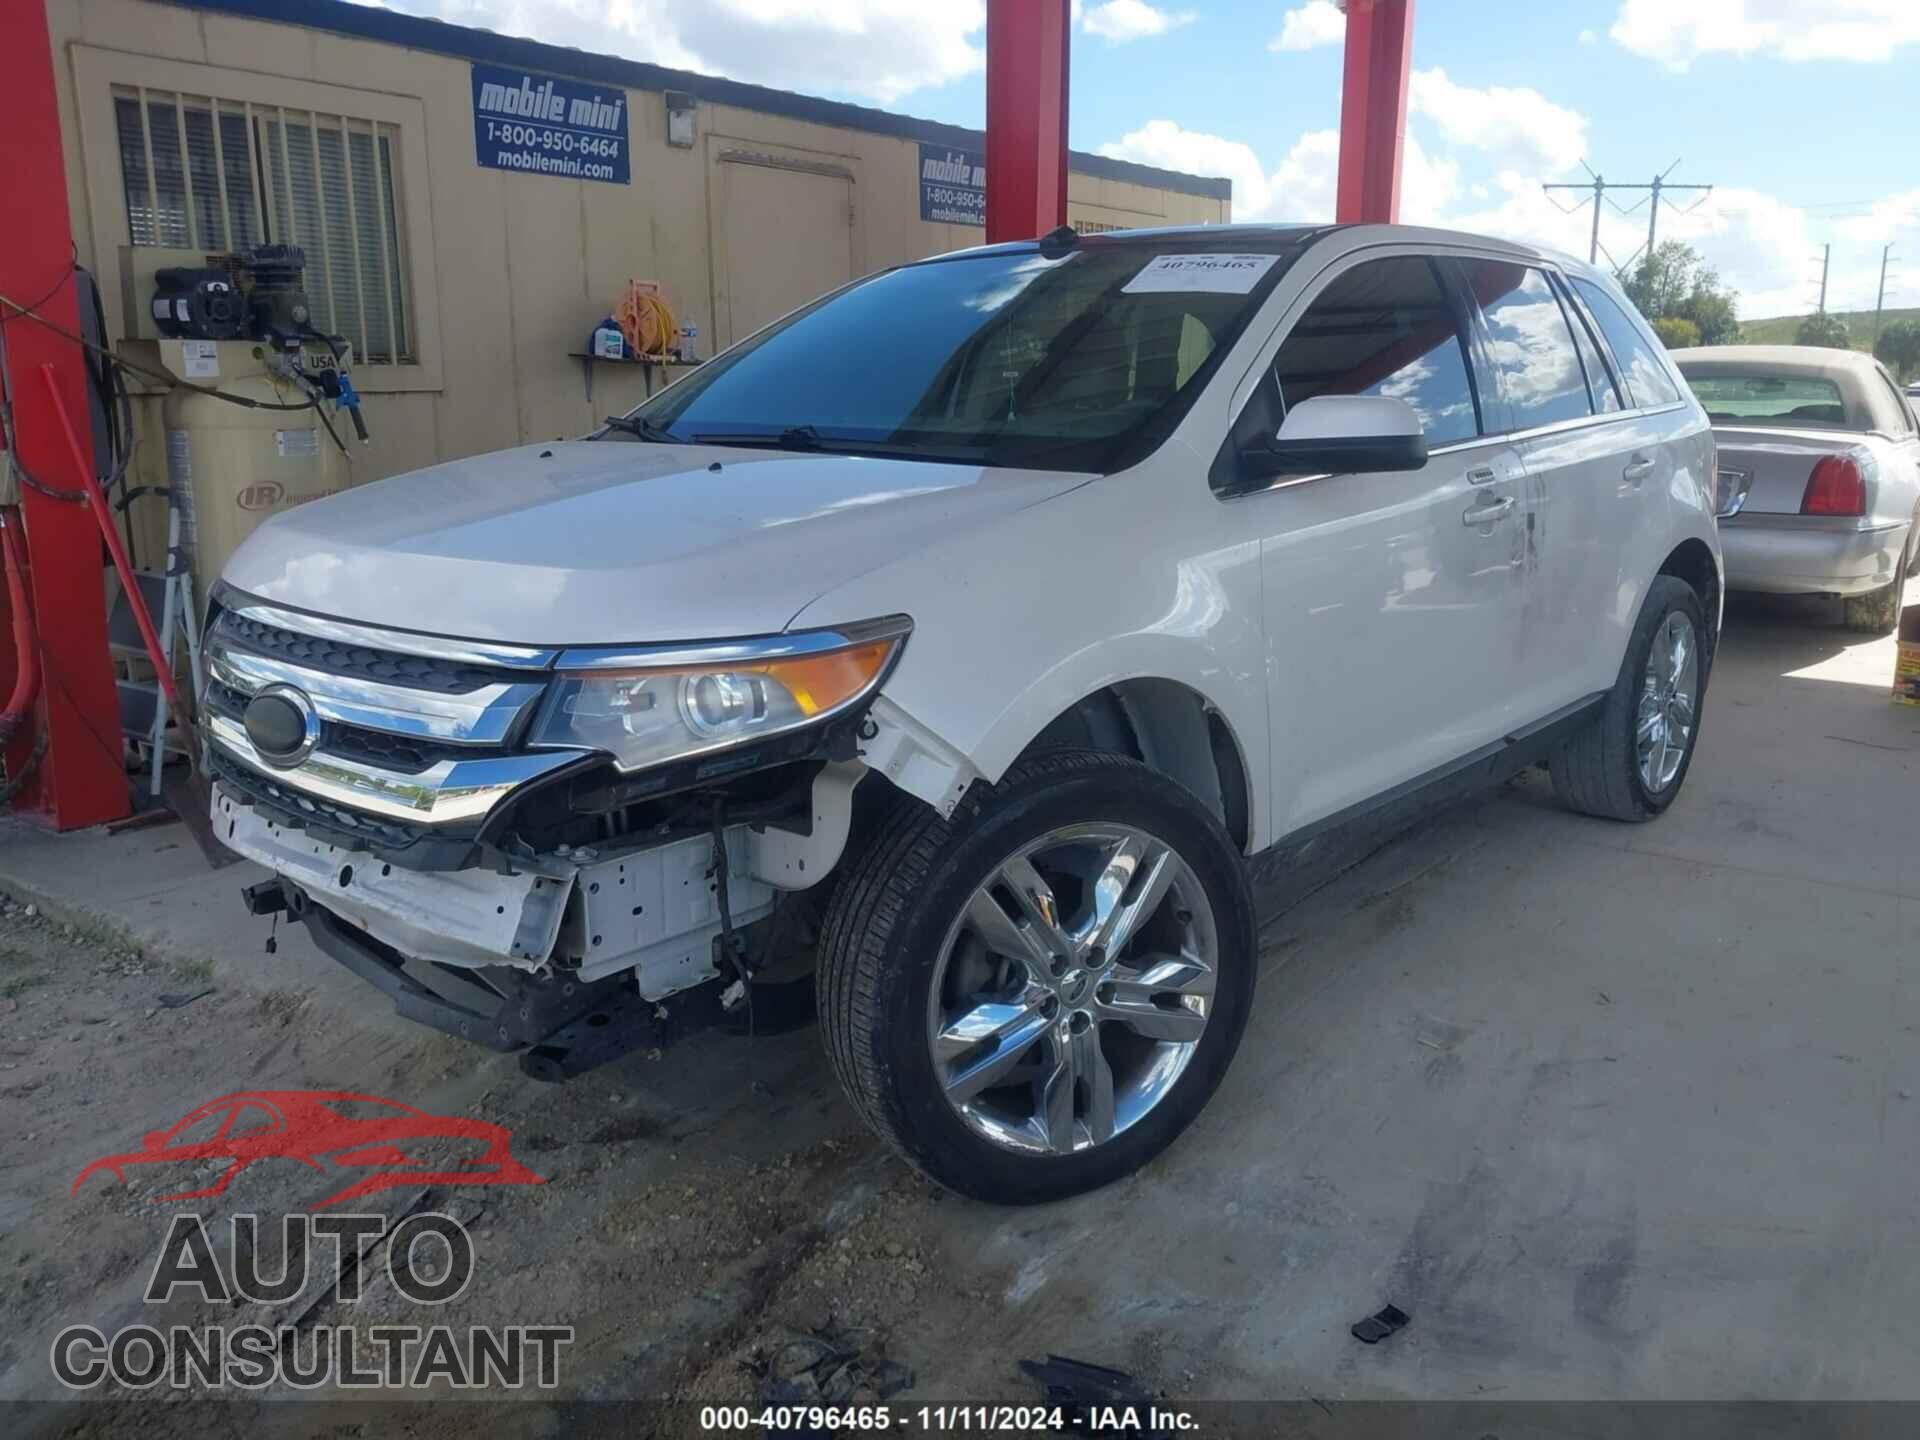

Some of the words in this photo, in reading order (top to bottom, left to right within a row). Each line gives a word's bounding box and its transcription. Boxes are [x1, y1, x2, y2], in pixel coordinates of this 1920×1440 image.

[479, 76, 566, 122] mobile
[568, 95, 623, 131] mini
[487, 121, 619, 159] 1-800-950-6464
[497, 150, 614, 179] mobilemini.com
[922, 151, 971, 186] mobile
[927, 187, 986, 209] 1-800-950-6
[931, 207, 986, 225] mobilemini.c
[311, 355, 336, 369] USA
